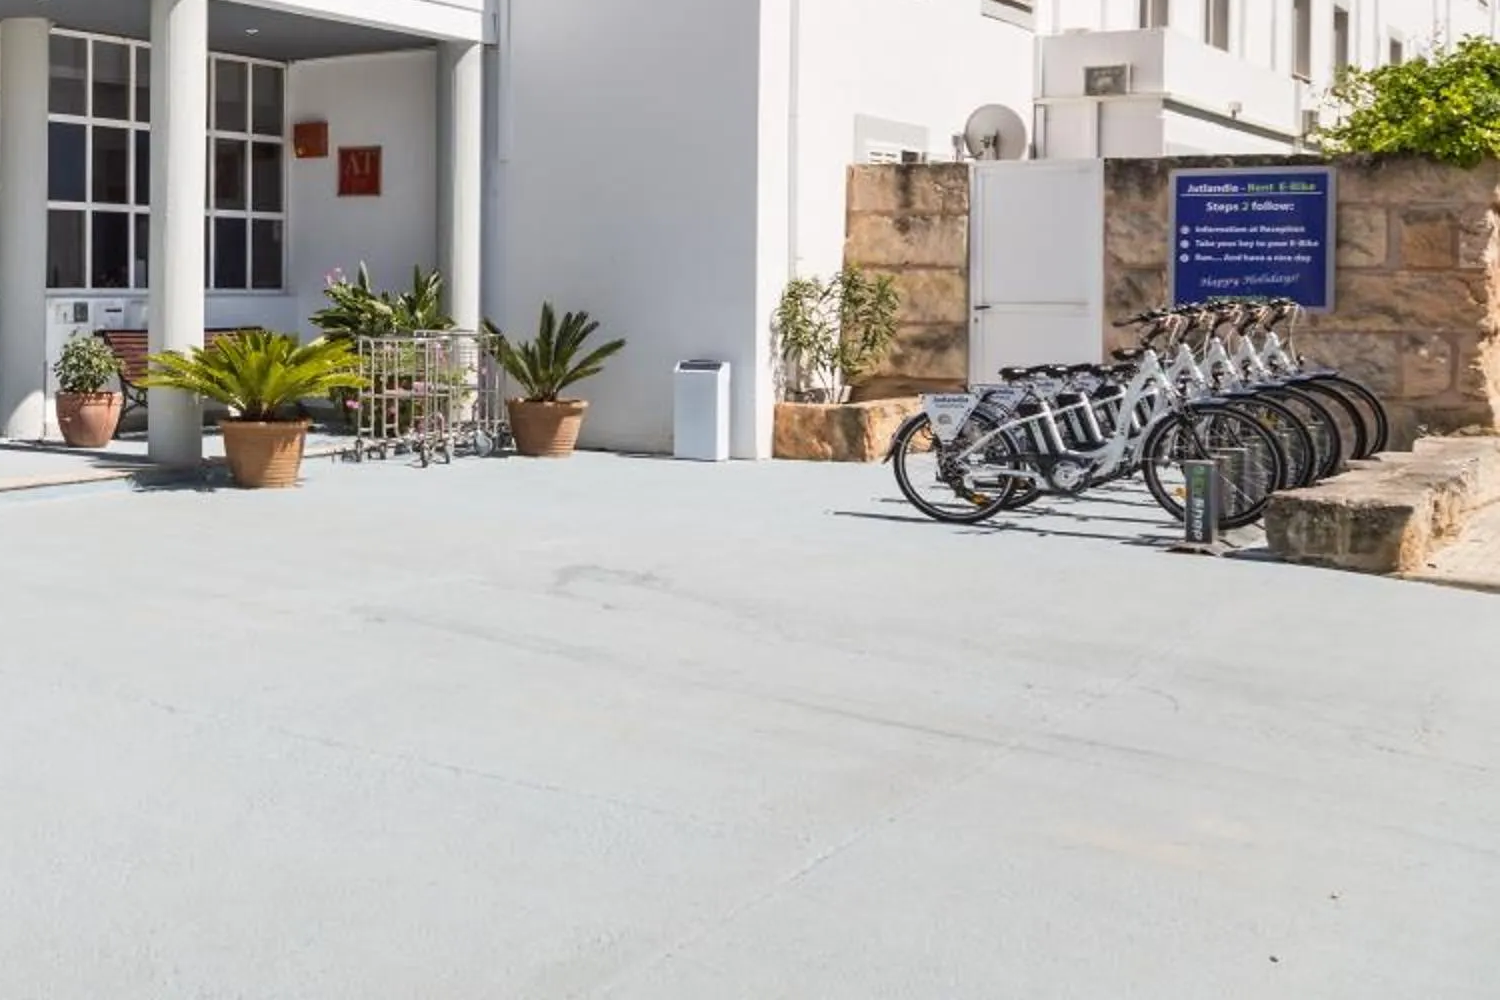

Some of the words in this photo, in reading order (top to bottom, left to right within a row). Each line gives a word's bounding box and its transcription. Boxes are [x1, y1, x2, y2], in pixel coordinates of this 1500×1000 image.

[1187, 183, 1239, 193] Jutlandia
[1205, 201, 1239, 214] Steps
[1241, 201, 1249, 212] 2
[1195, 225, 1247, 233] Information
[1259, 225, 1305, 234] Reception
